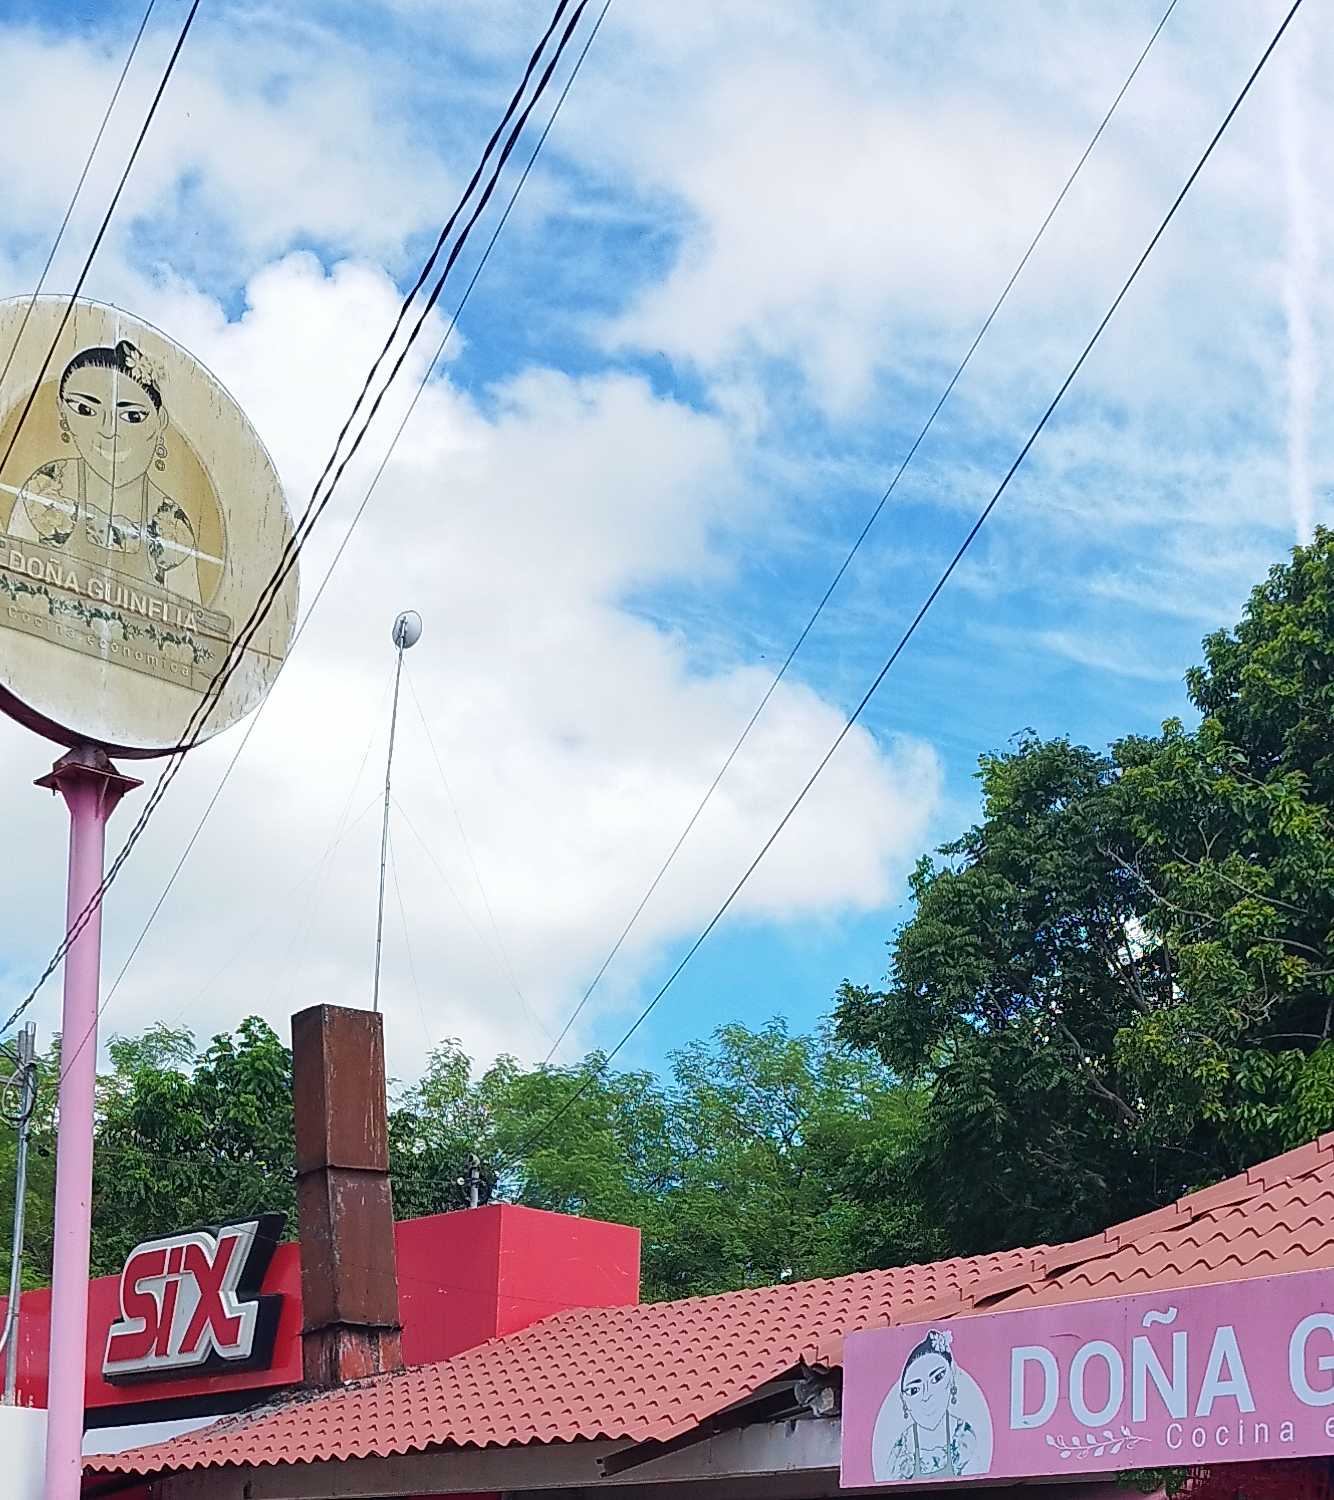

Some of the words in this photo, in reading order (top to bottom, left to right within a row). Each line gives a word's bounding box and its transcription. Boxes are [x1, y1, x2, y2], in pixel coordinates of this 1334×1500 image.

[7, 549, 80, 595] DOÑA
[7, 605, 76, 640] Cocina
[1008, 1306, 1256, 1430] DOÑA
[1164, 1413, 1298, 1451] Cocina
